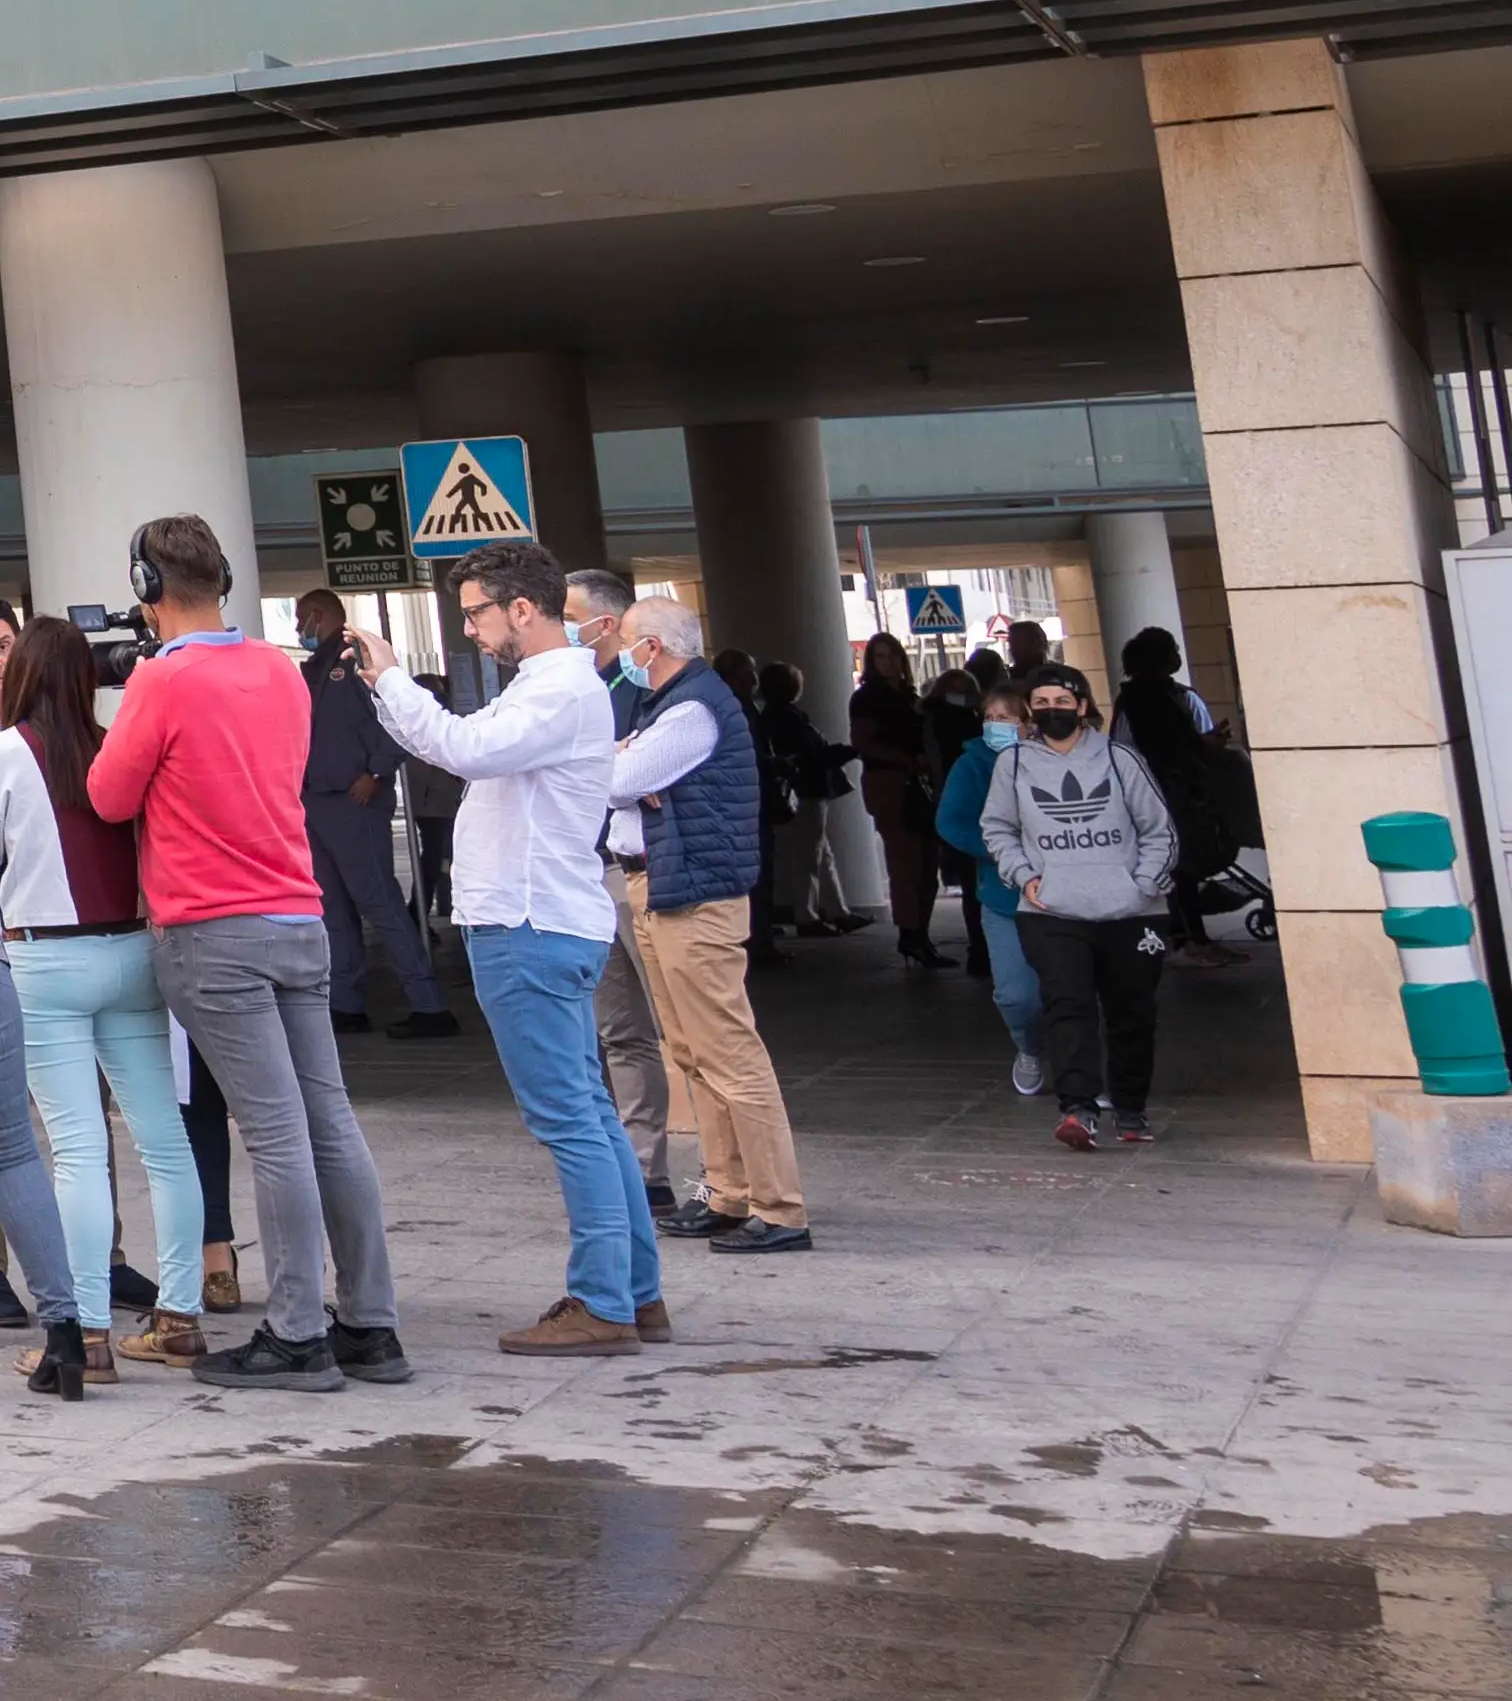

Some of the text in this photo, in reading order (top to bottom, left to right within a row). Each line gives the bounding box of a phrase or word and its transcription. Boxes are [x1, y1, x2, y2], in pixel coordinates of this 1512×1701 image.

[335, 561, 400, 573] PUNTO DE
[1038, 828, 1123, 851] adidas
